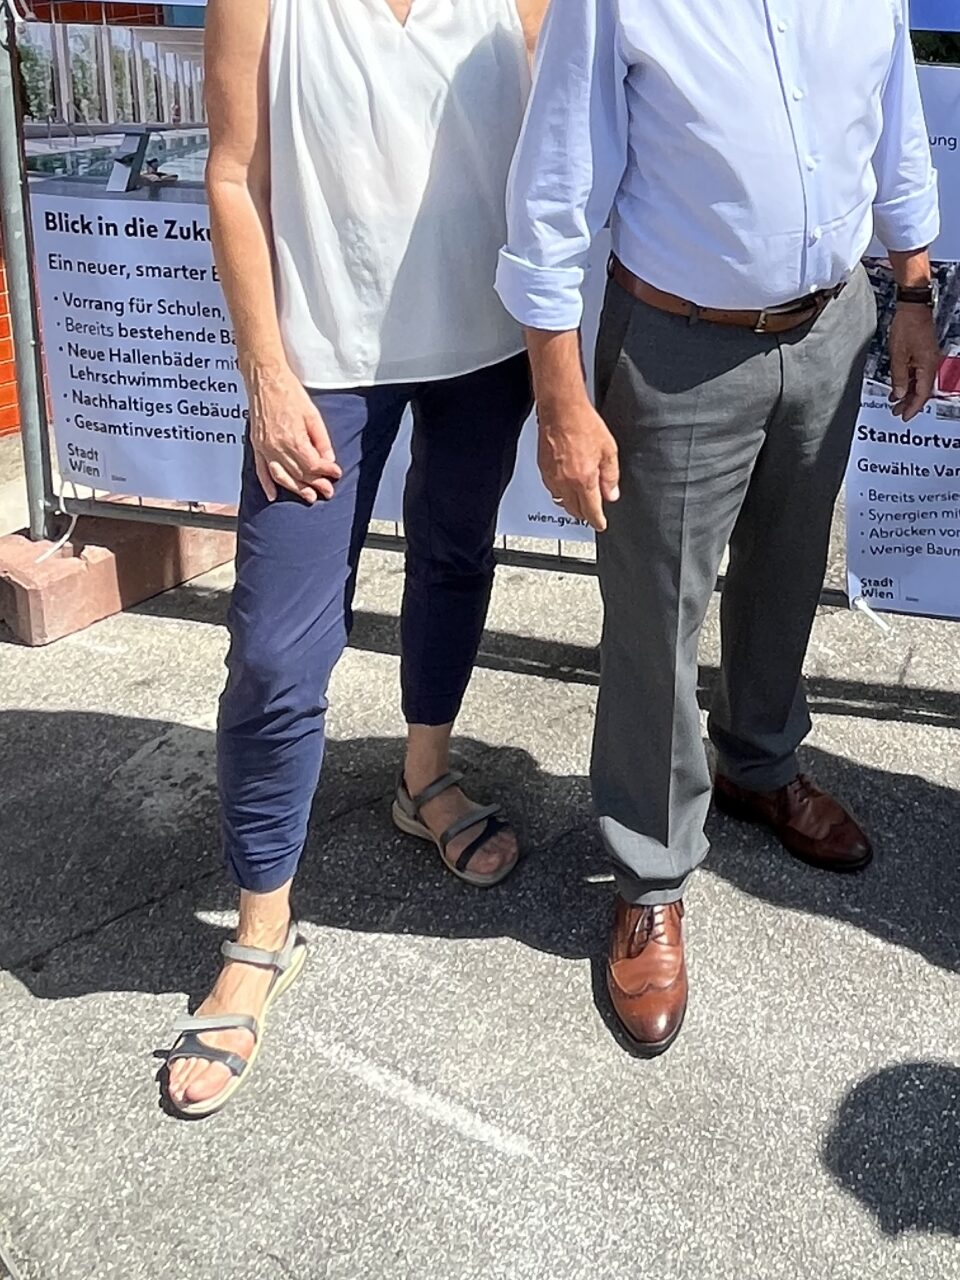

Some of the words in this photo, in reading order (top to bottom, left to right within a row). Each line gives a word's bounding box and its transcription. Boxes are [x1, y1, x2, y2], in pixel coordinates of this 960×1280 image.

[45, 211, 93, 235] Blick
[98, 216, 118, 237] in
[125, 217, 158, 239] die
[49, 254, 73, 271] Ein
[77, 259, 130, 280] neuer,
[135, 265, 207, 282] smarter
[63, 291, 125, 317] Vorrang
[129, 297, 153, 314] für
[157, 299, 225, 322] Schulen,
[66, 317, 114, 337] Bereits
[118, 323, 216, 344] bestehende
[68, 342, 106, 361] Neue
[109, 348, 211, 369] Hallenbäder
[70, 364, 238, 394] Lehrschwimmbecken
[72, 389, 173, 417] Nachhaltiges
[177, 399, 249, 420] Gebäude
[74, 414, 237, 445] Gesamtinvestitionen
[67, 443, 99, 461] Stadt
[69, 458, 100, 477] Wien
[857, 458, 930, 477] Gewählte
[868, 489, 915, 503] Bereits
[868, 509, 938, 524] Synergien
[869, 527, 936, 539] Abrücken
[870, 543, 923, 557] Wenige
[860, 577, 894, 588] Stadt
[861, 588, 894, 600] Wien
